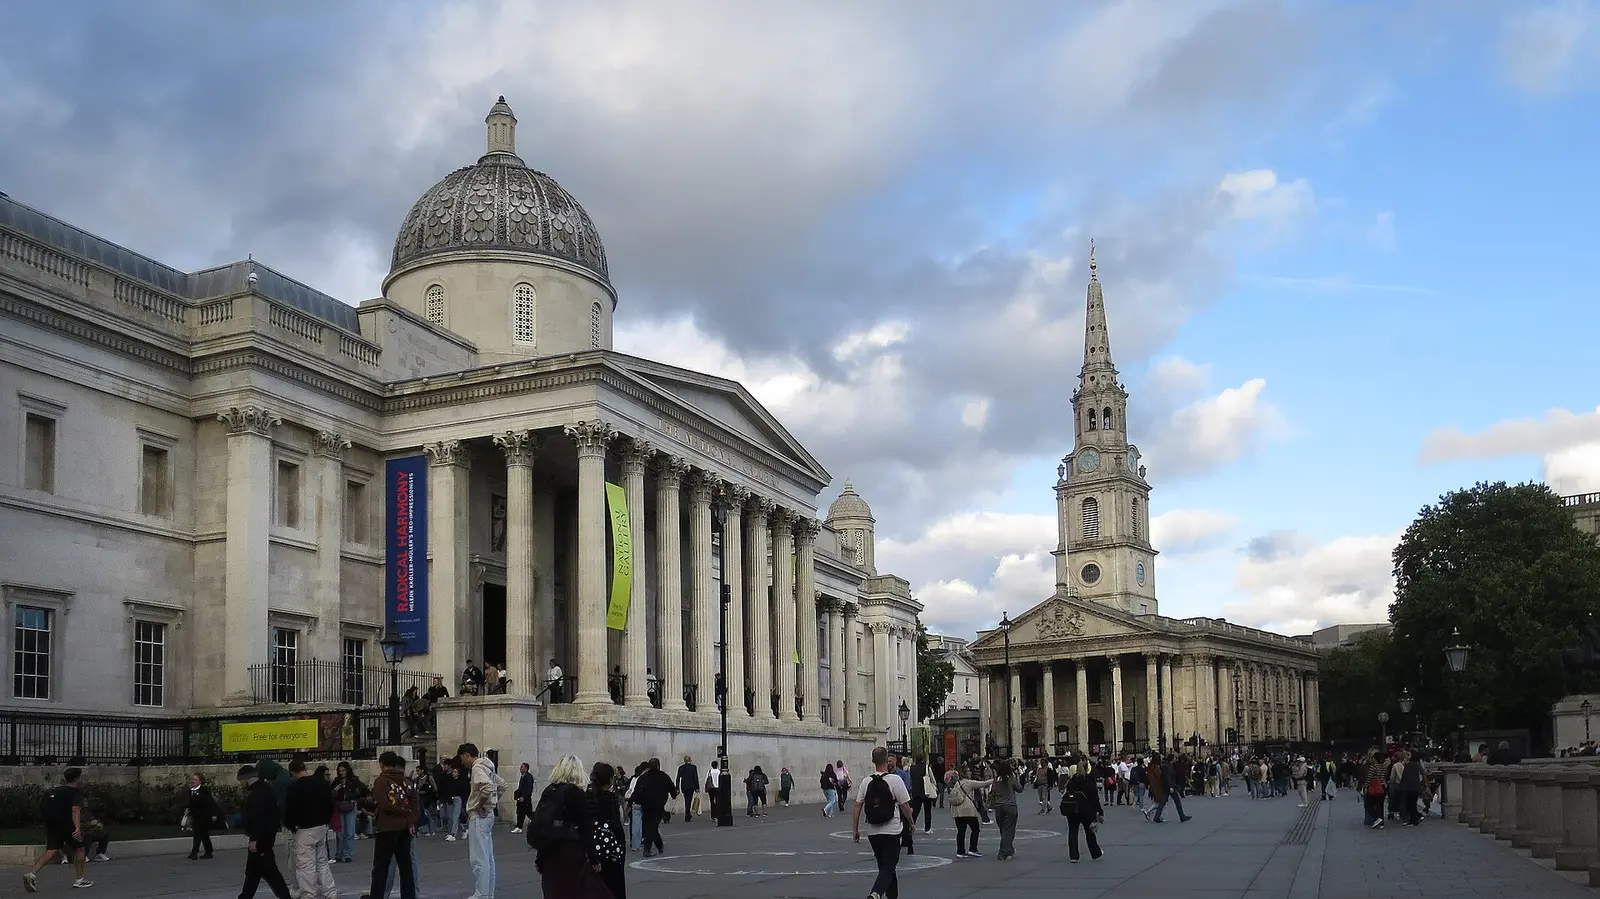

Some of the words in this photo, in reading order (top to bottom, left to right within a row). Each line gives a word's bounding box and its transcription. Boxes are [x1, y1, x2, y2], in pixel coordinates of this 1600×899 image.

[397, 471, 408, 547] HARMONY
[397, 551, 408, 612] RADICAL
[253, 733, 267, 741] Free
[268, 732, 278, 740] for
[279, 732, 308, 741] everyone
